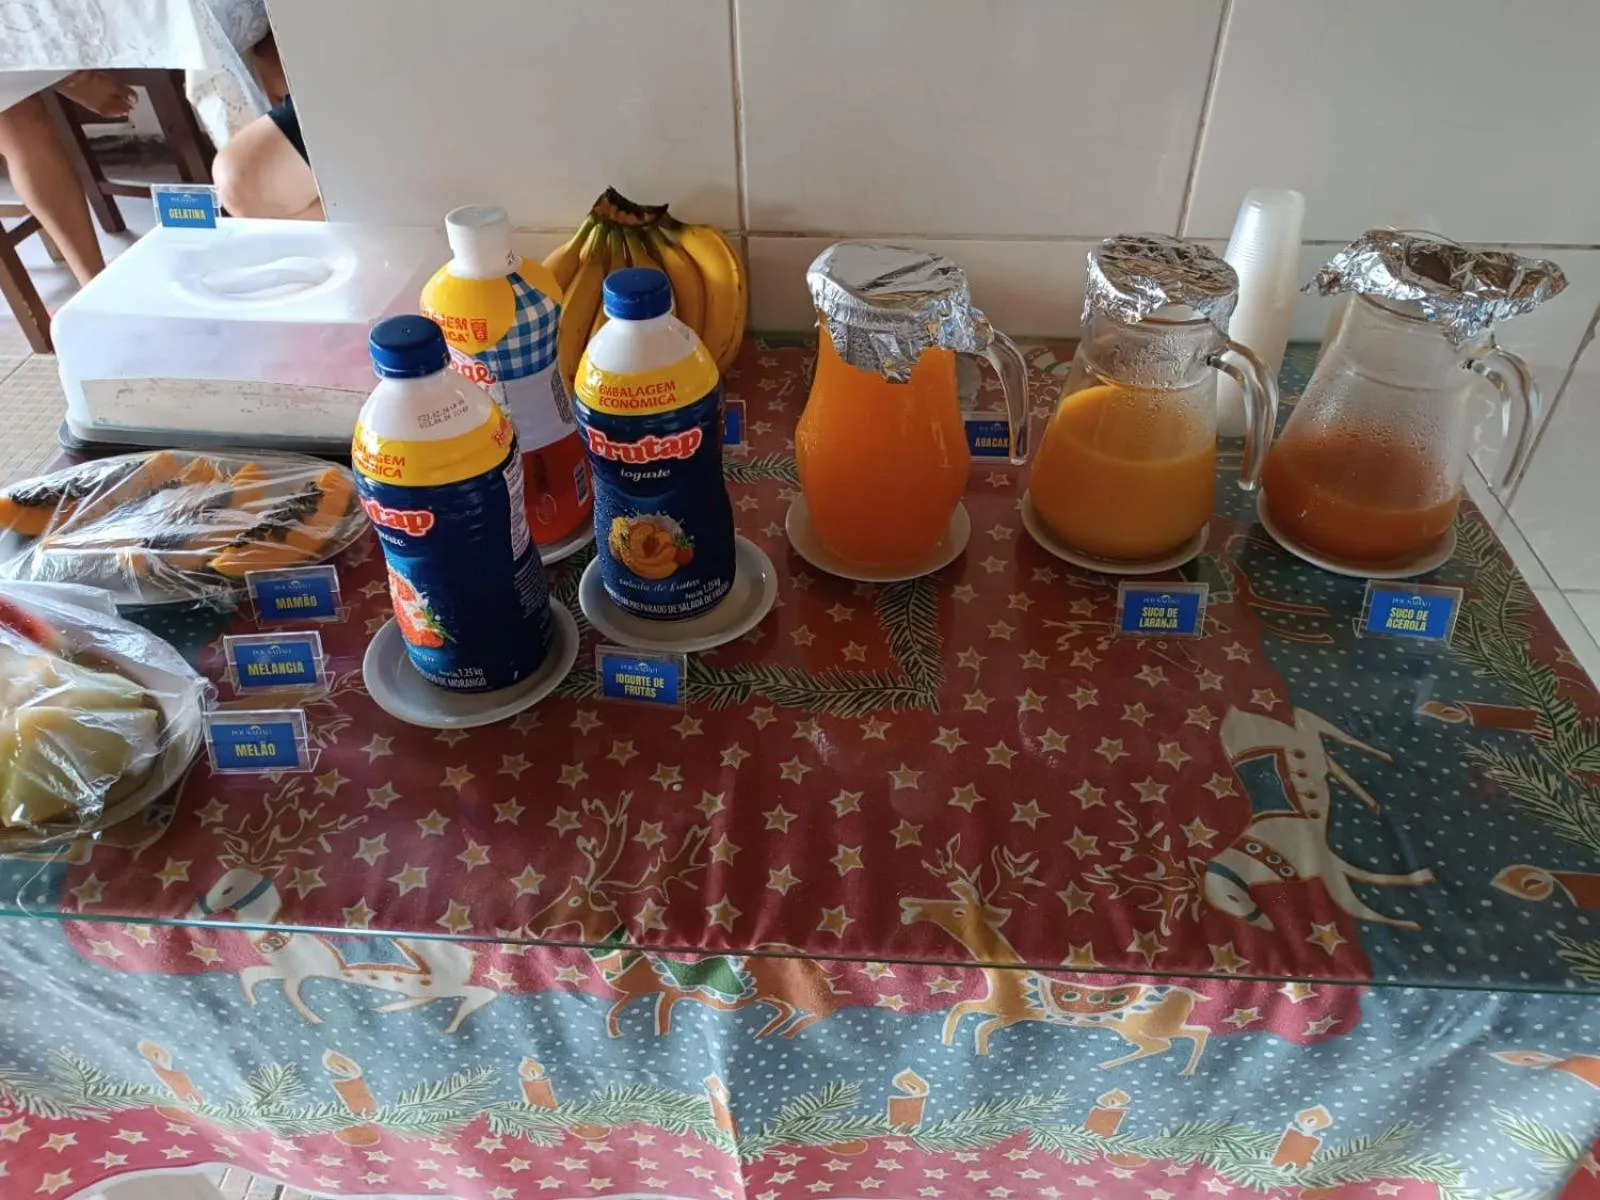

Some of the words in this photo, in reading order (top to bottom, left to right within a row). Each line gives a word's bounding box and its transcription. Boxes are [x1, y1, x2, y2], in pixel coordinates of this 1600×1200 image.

[168, 208, 207, 220] GELATINA
[599, 380, 677, 397] EMBALAGEM
[587, 426, 702, 464] Frutap
[974, 437, 1010, 448] ABACAX
[275, 593, 318, 609] MAMÃO
[1142, 606, 1165, 618] SUCO
[1166, 607, 1179, 618] DE
[1390, 607, 1415, 620] SUCO
[1416, 610, 1430, 621] DE
[1139, 617, 1178, 629] LARANJA
[1385, 617, 1428, 632] ACEROLA
[247, 661, 305, 676] MELANCIA
[615, 673, 652, 687] IOGURTE
[653, 676, 665, 689] DE
[624, 684, 657, 698] FRUTAS
[234, 741, 277, 757] MELÃO
